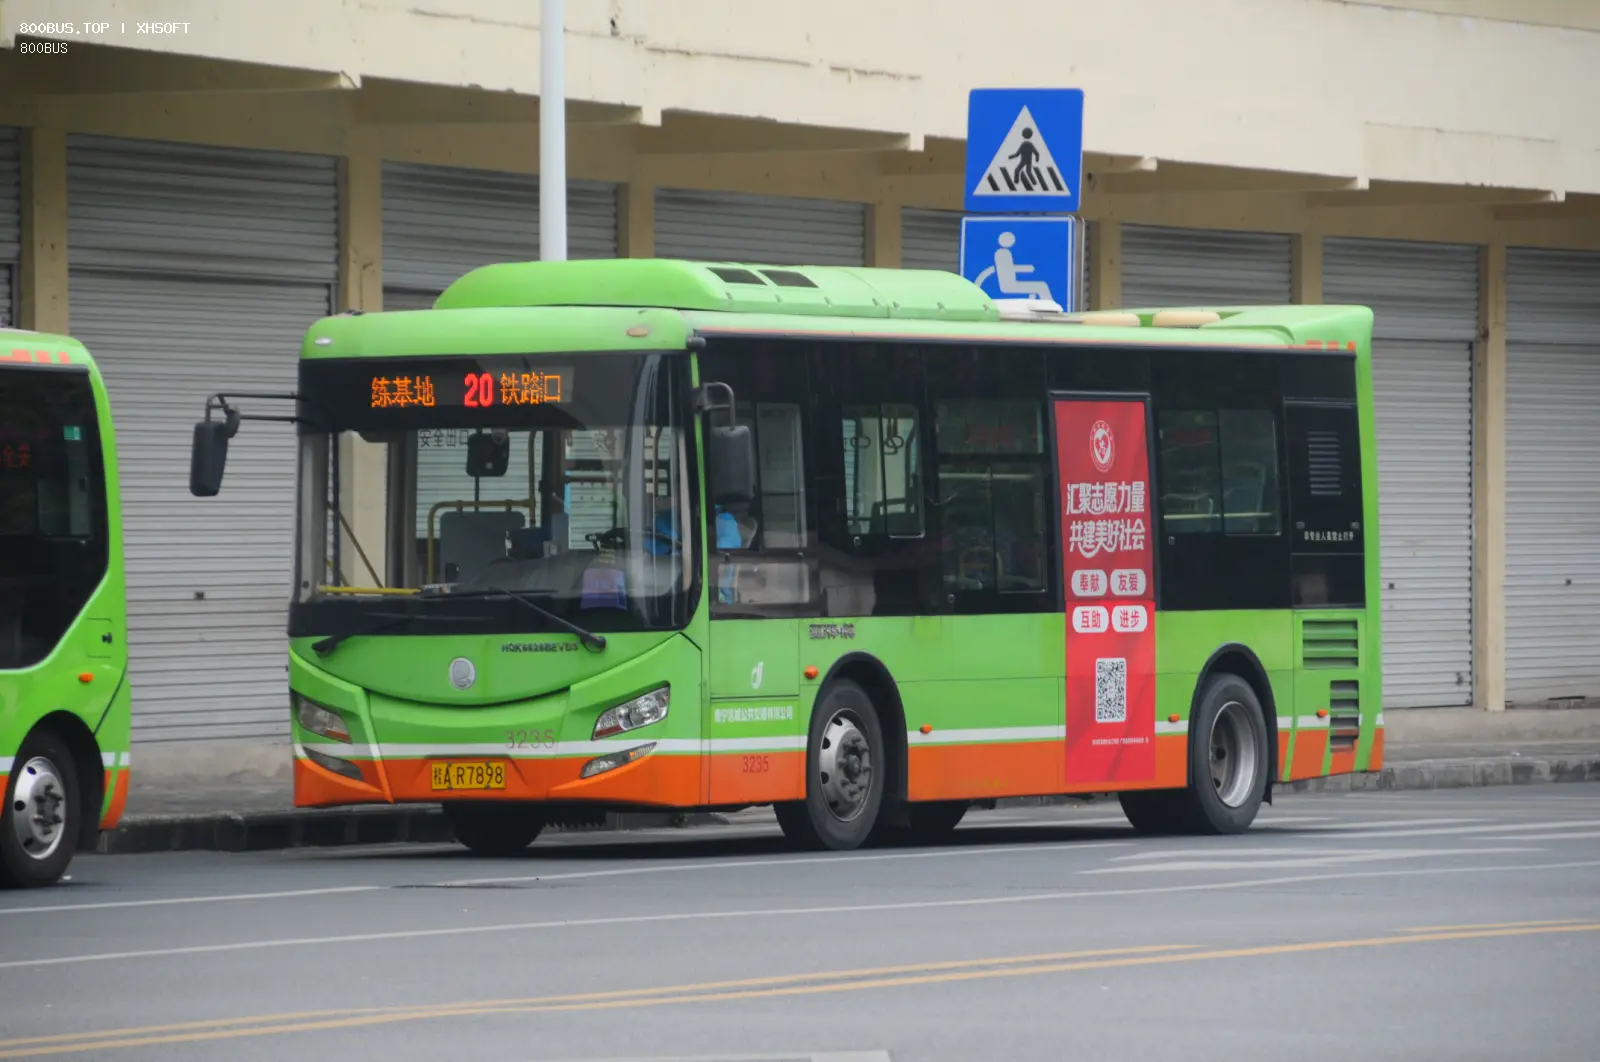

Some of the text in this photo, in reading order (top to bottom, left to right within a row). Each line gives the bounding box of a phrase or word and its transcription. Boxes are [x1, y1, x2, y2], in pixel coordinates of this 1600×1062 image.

[371, 372, 561, 408] 练基地 20 铁路口
[1066, 481, 1145, 515] 汇聚志愿力量
[1069, 518, 1145, 558] 共建美好社会
[1079, 572, 1139, 592] 奉献 友爱
[1080, 609, 1141, 628] 互助 进步
[503, 728, 556, 749] 3235
[742, 755, 769, 773] 3235
